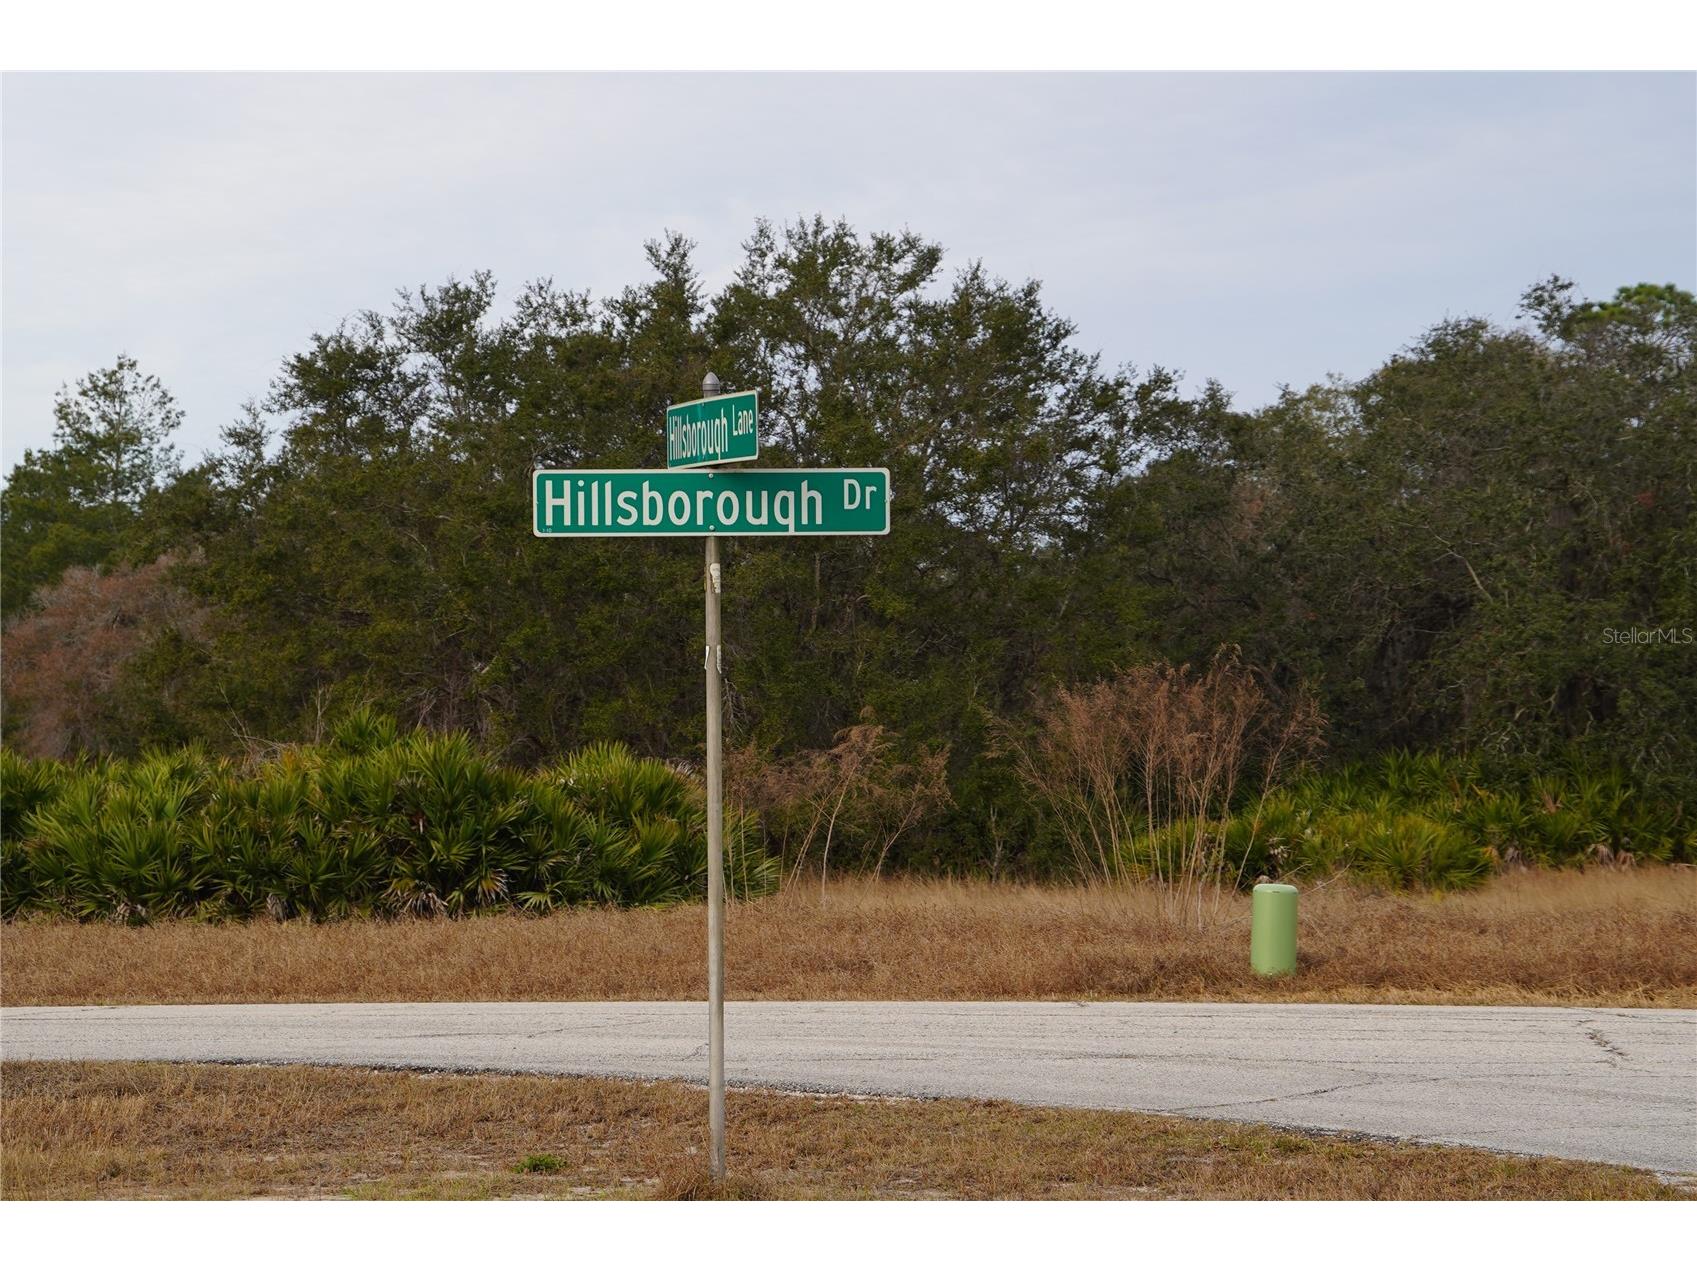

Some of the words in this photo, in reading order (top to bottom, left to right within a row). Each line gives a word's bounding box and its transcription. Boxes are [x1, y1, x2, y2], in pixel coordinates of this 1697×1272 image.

[669, 407, 728, 461] Hillsborough
[732, 403, 754, 436] Lane
[545, 479, 823, 533] Hillsborough
[843, 479, 877, 510] Dr
